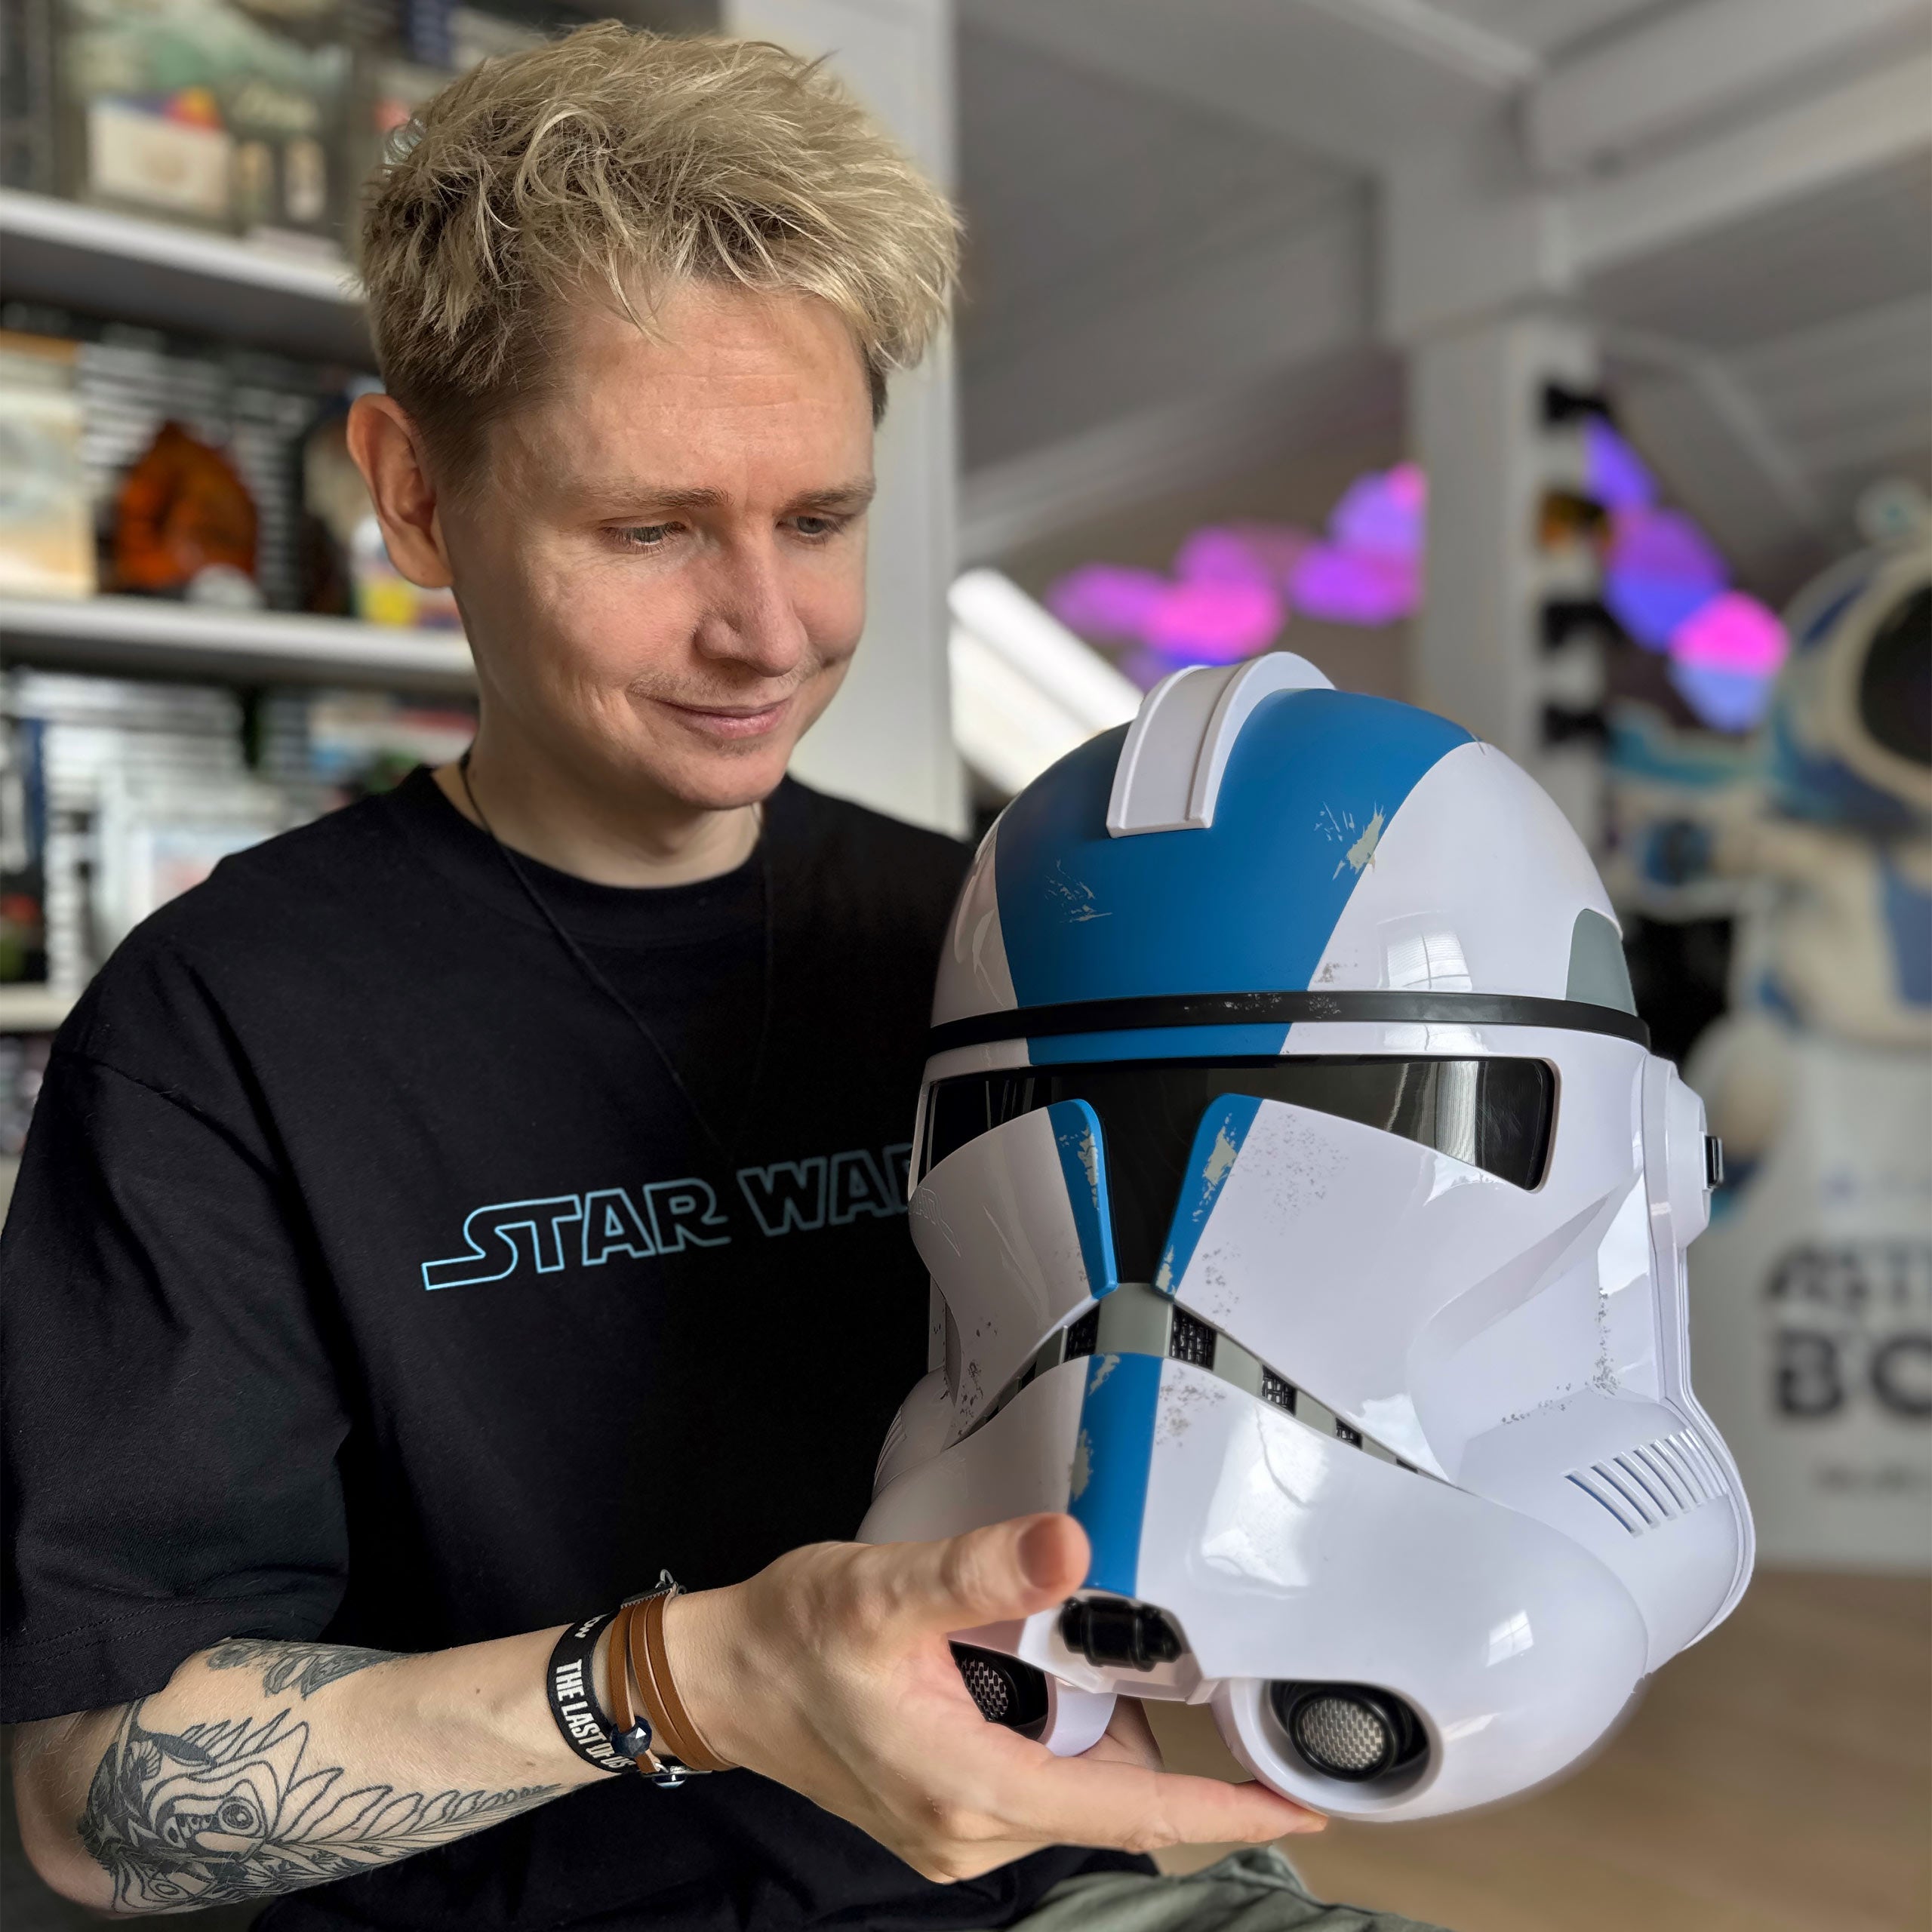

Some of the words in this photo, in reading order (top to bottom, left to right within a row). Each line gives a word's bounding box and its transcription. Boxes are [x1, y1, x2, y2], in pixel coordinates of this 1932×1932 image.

[421, 1178, 731, 1290] STAR
[555, 1659, 585, 1702] THE
[561, 1700, 607, 1745] LAST
[600, 1755, 636, 1769] US
